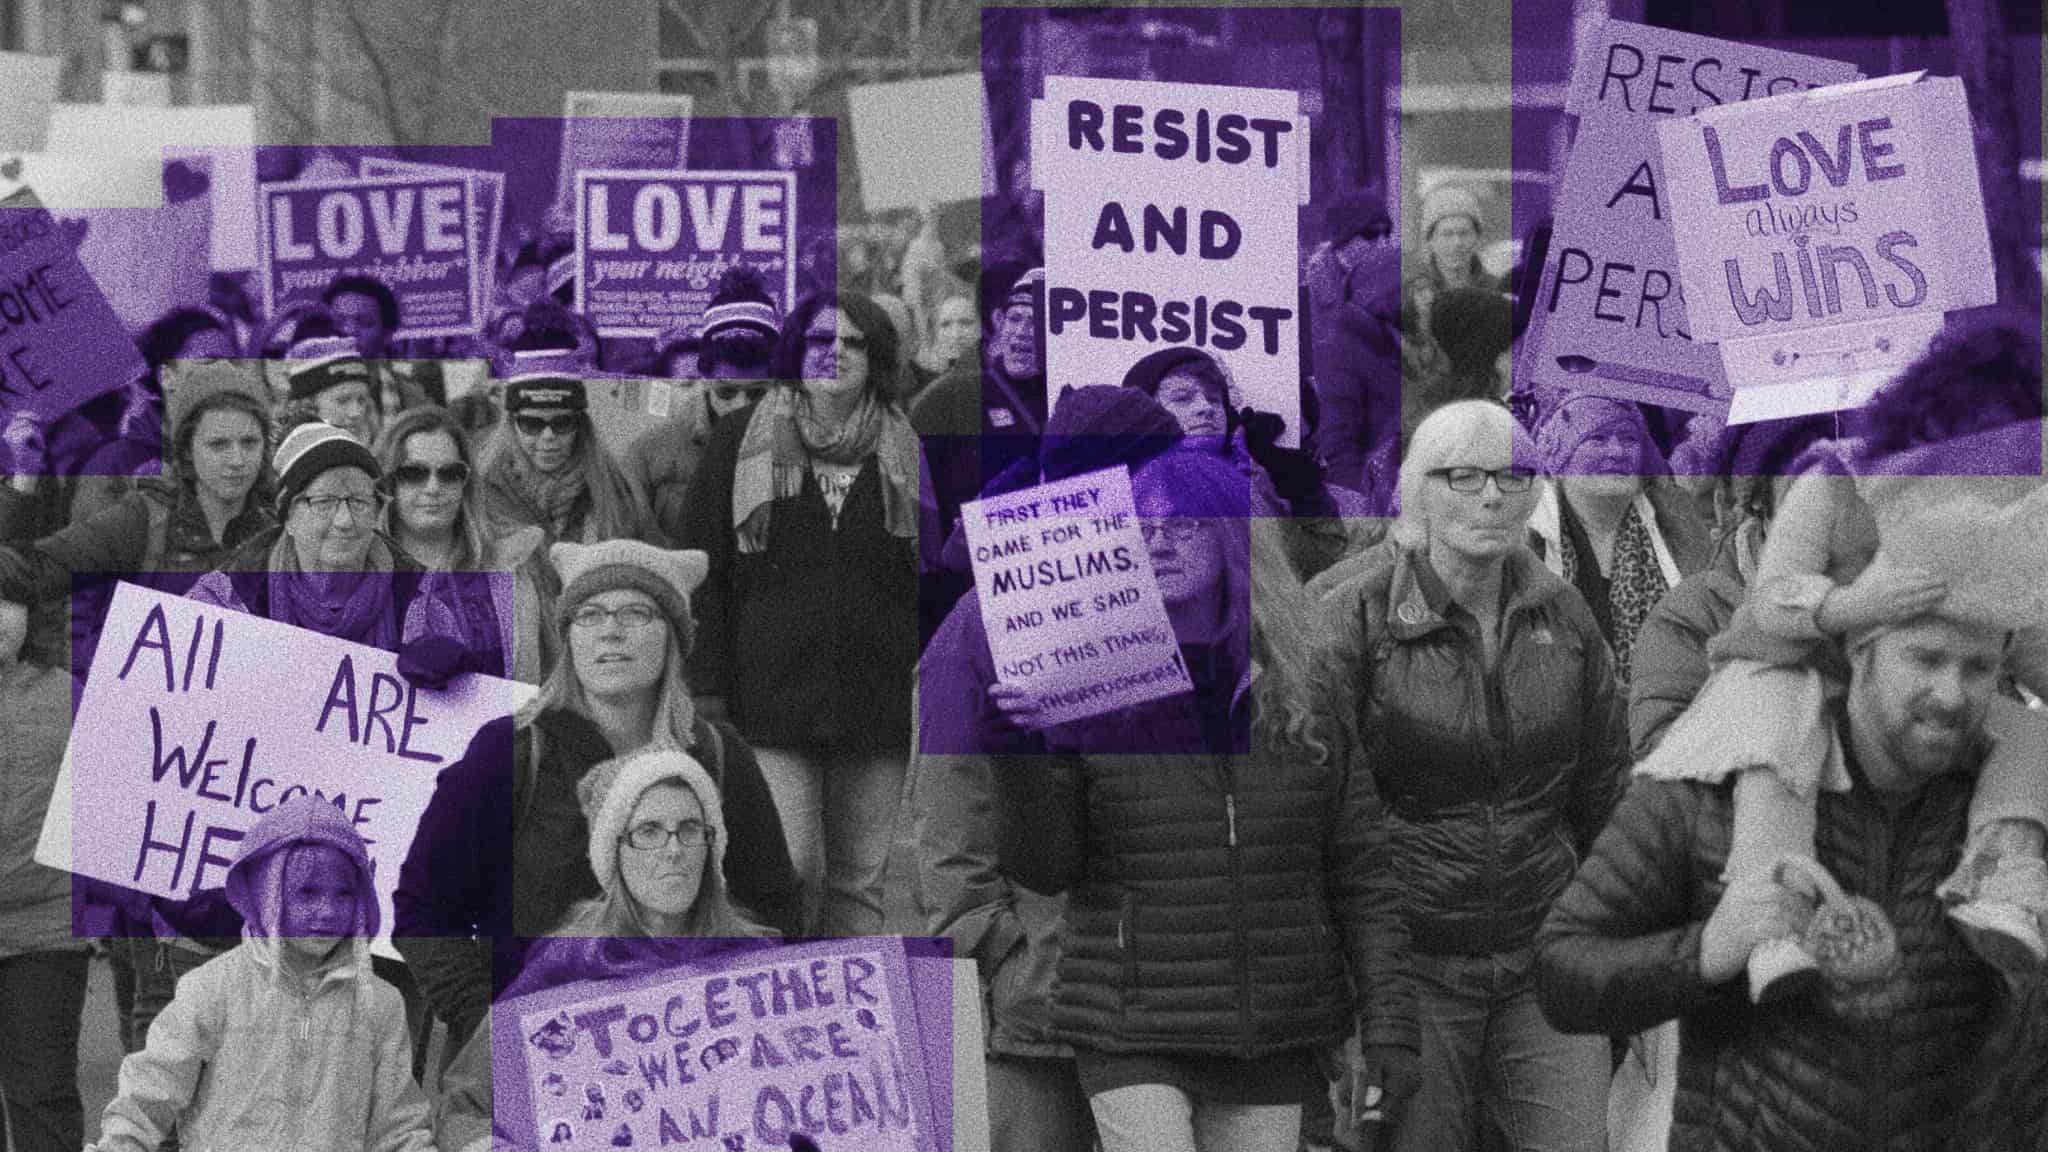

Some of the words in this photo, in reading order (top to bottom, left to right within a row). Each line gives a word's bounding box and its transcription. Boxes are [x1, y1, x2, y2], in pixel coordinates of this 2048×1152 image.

[1599, 44, 1822, 115] RESI
[1068, 100, 1292, 168] RESIST
[1703, 116, 1905, 204] LOVE
[274, 187, 464, 261] LOVE
[587, 183, 783, 252] LOVE
[1092, 202, 1242, 260] AND
[1746, 200, 1859, 238] always
[0, 264, 73, 334] OME
[1049, 287, 1292, 355] PERSIST
[985, 501, 1040, 529] FIRST
[1051, 488, 1100, 514] THEY
[1041, 523, 1082, 545] FOR
[1091, 511, 1130, 535] THE
[992, 546, 1139, 596] MUSLIMS.
[1005, 611, 1044, 633] AND
[1051, 601, 1083, 621] WE
[1094, 587, 1140, 613] SAID
[1003, 653, 1043, 678] NOT
[1049, 641, 1098, 666] THIS
[316, 653, 443, 763] ARE
[638, 1040, 696, 1091] WE
[750, 1022, 859, 1070] ARE
[658, 1087, 720, 1147] AN
